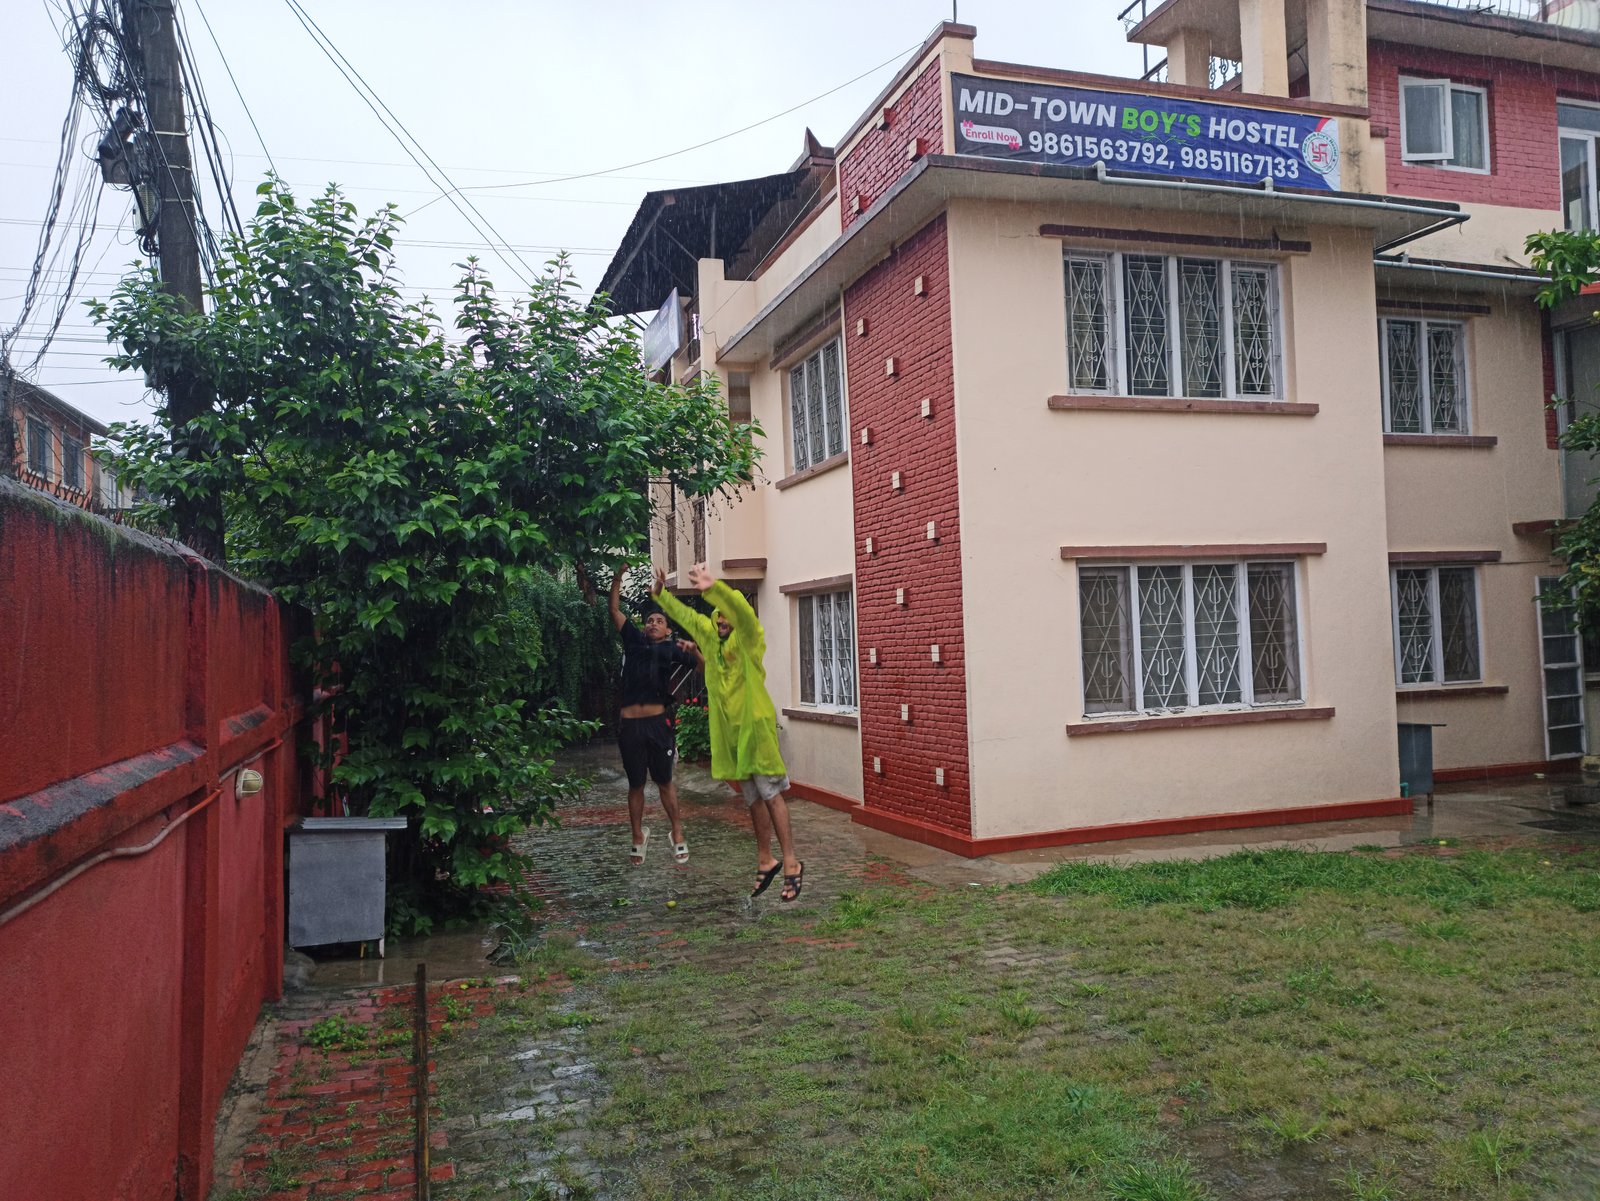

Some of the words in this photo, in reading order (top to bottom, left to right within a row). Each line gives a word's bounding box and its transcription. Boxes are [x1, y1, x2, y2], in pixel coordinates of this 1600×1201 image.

[959, 88, 1116, 128] MID-TOWN
[1121, 107, 1201, 138] BOY'S
[1208, 116, 1300, 149] HOSTEL
[965, 127, 993, 141] Enroll
[995, 131, 1018, 143] Now
[1028, 130, 1175, 170] 9861563792,
[1181, 148, 1299, 179] 9851167133
